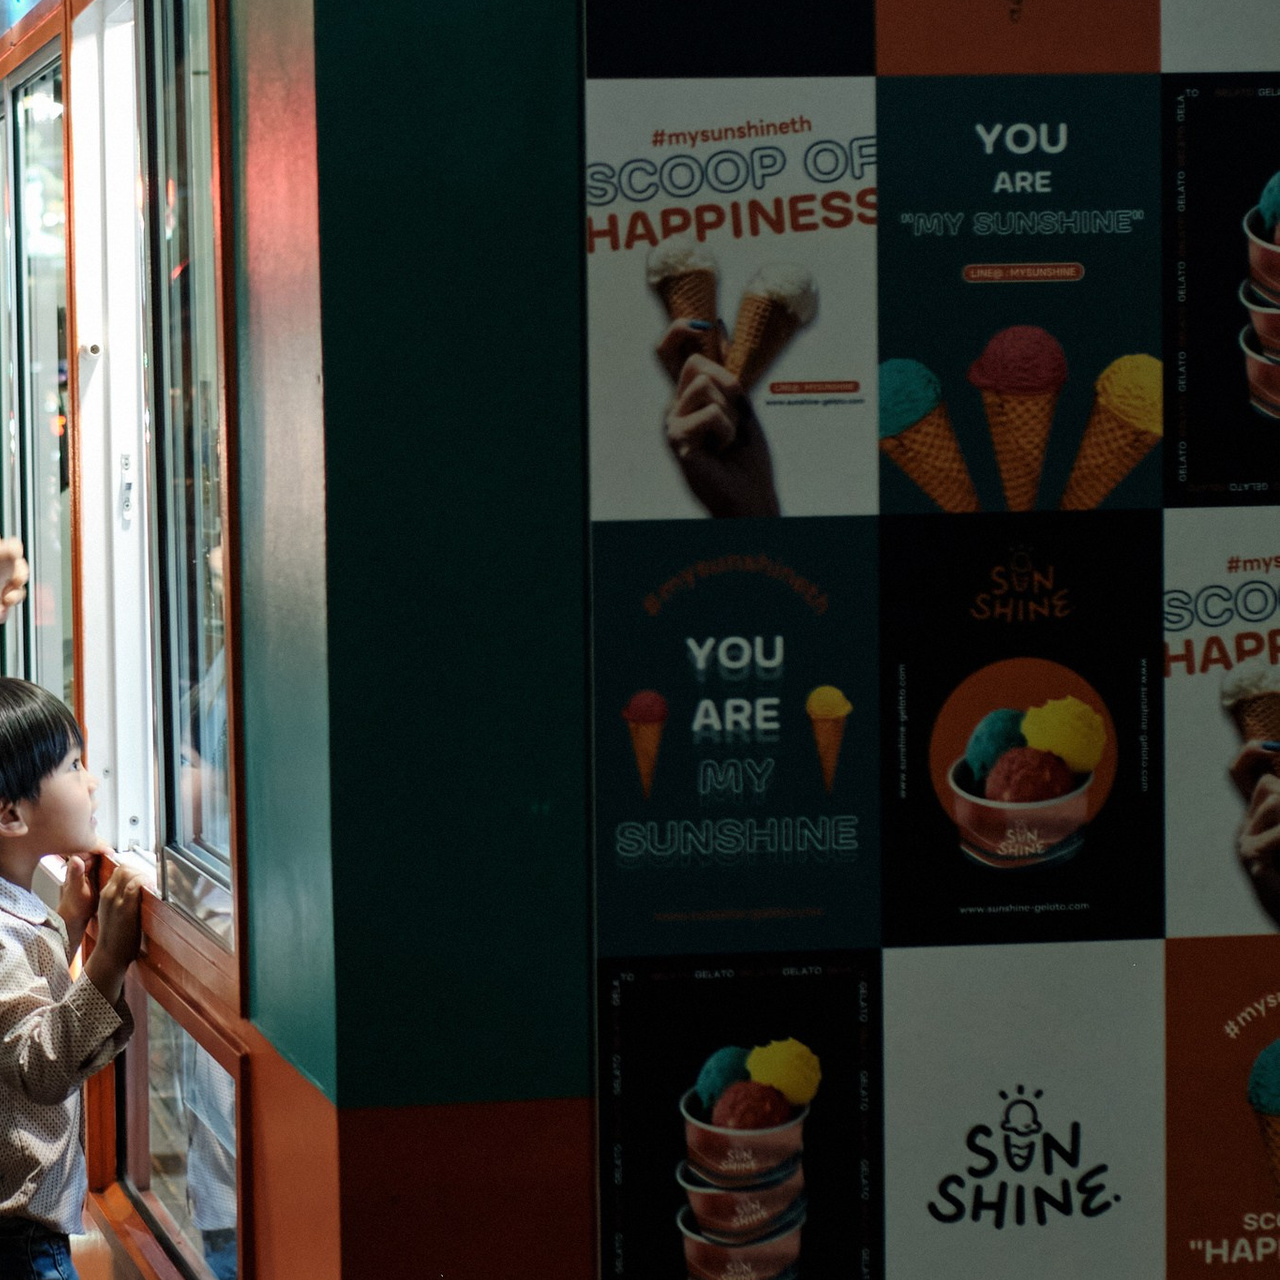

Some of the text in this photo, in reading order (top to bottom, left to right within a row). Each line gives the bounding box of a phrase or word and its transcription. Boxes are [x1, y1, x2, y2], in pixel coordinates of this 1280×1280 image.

[651, 115, 813, 148] #mysunshineth
[974, 122, 1068, 156] YOU
[587, 135, 877, 207] SCOOP OF
[992, 170, 1053, 194] ARE
[586, 187, 878, 254] HAPPINESS
[685, 634, 785, 673] YOU
[691, 696, 782, 733] ARE
[697, 757, 776, 796] MY
[615, 814, 860, 858] SUNSHINE
[958, 901, 1091, 915] www.sunshine-gelato.com
[1223, 991, 1280, 1040] #mys
[966, 1120, 1081, 1179] SUN
